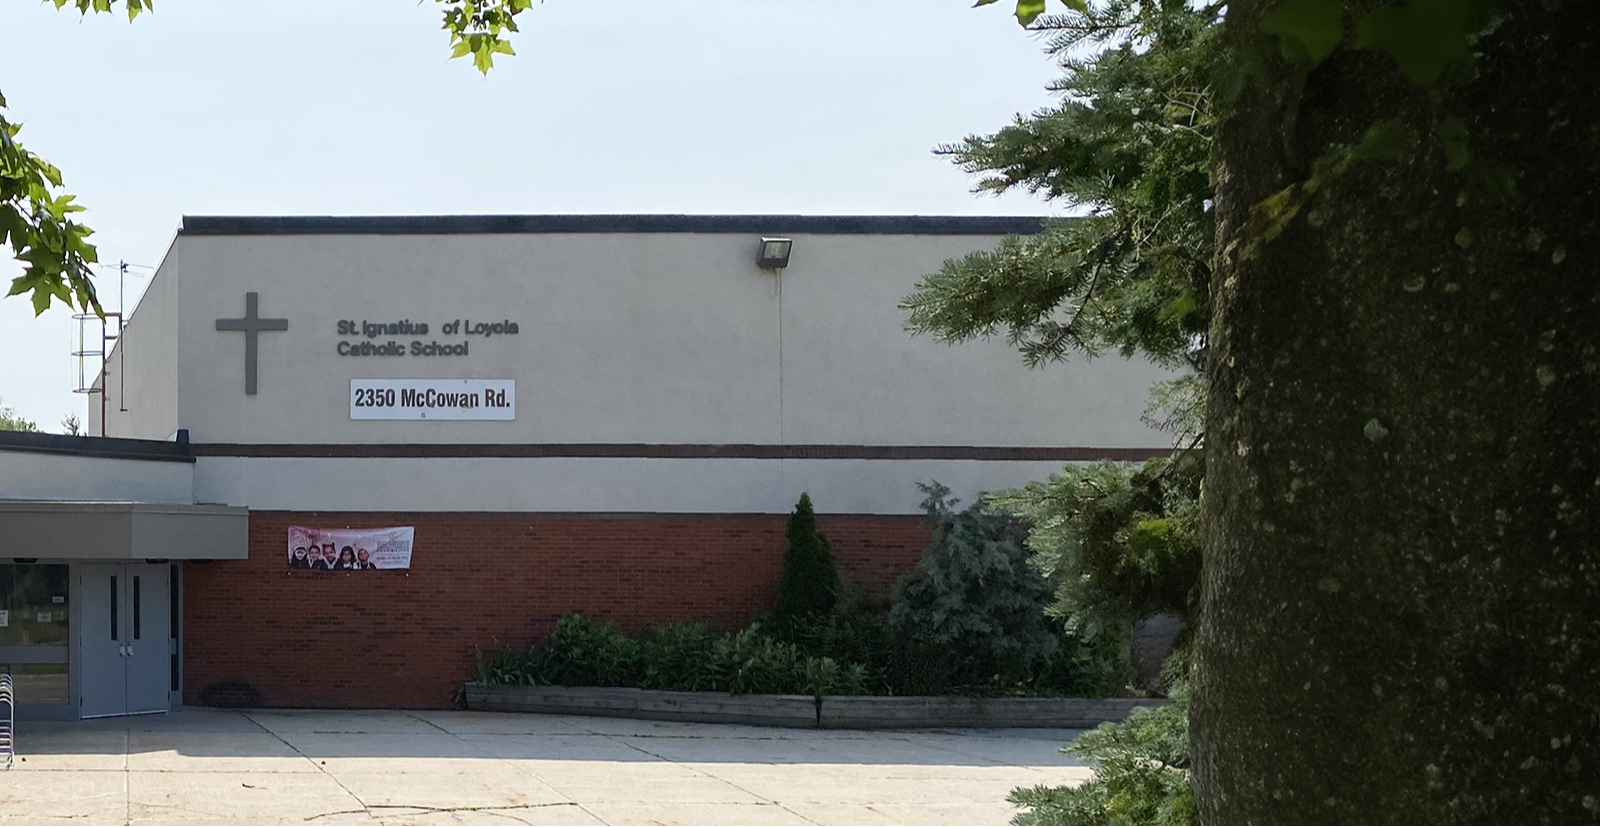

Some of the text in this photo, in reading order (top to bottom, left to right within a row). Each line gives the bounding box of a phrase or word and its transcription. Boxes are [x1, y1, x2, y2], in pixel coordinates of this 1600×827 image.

[337, 319, 519, 338] St. Ignatius of Loyola
[337, 341, 469, 357] Catholic School
[355, 388, 511, 408] 2350 McCowan Rd.
